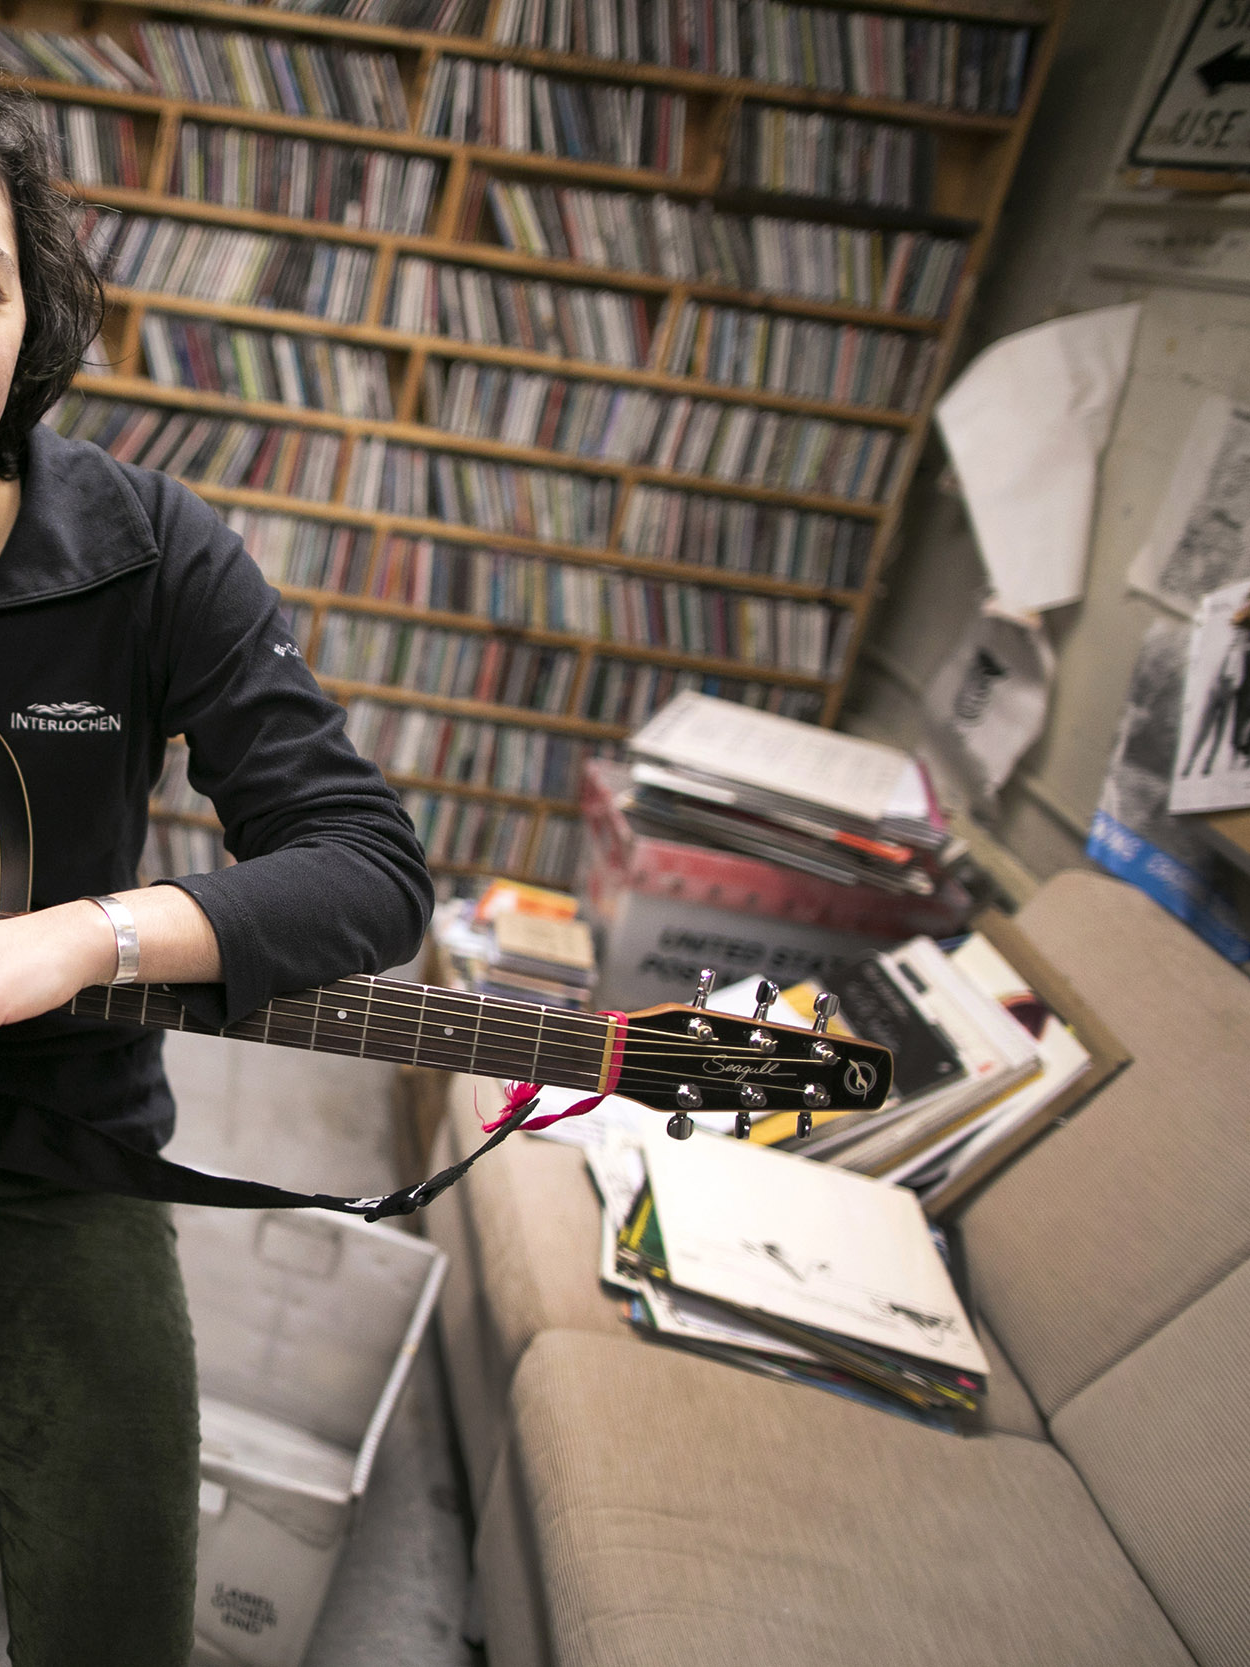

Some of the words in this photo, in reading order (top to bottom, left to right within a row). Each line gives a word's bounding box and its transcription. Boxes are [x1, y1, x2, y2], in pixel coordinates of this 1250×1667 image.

[1167, 108, 1248, 147] USE
[11, 711, 121, 731] INTERLOCHEN
[659, 925, 767, 965] UNITED
[703, 1054, 797, 1084] Seagull
